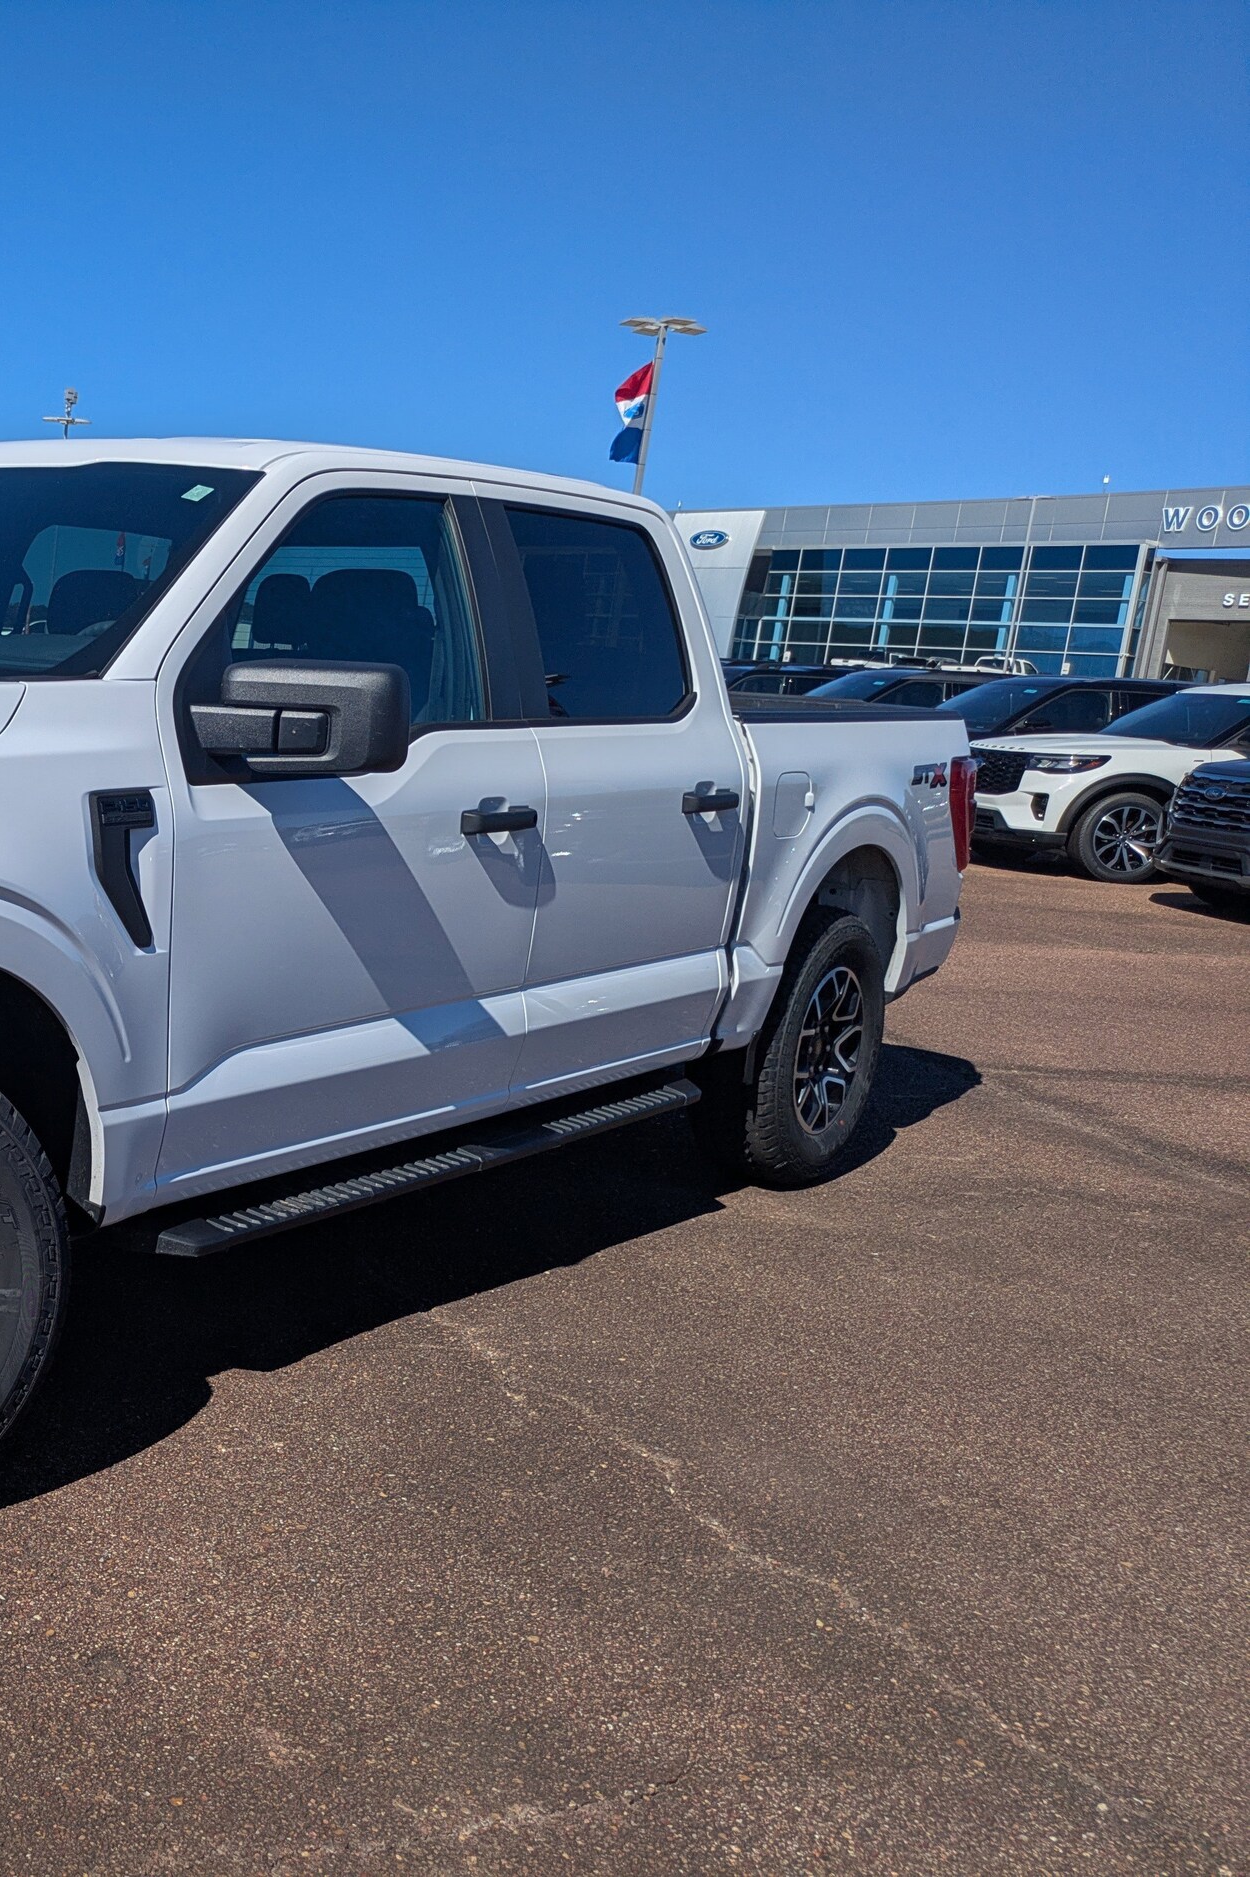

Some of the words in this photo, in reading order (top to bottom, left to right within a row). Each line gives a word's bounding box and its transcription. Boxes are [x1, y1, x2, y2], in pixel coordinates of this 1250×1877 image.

[1162, 504, 1250, 532] WOO
[696, 533, 720, 545] Ford
[1222, 593, 1250, 608] SE
[911, 762, 948, 789] STX
